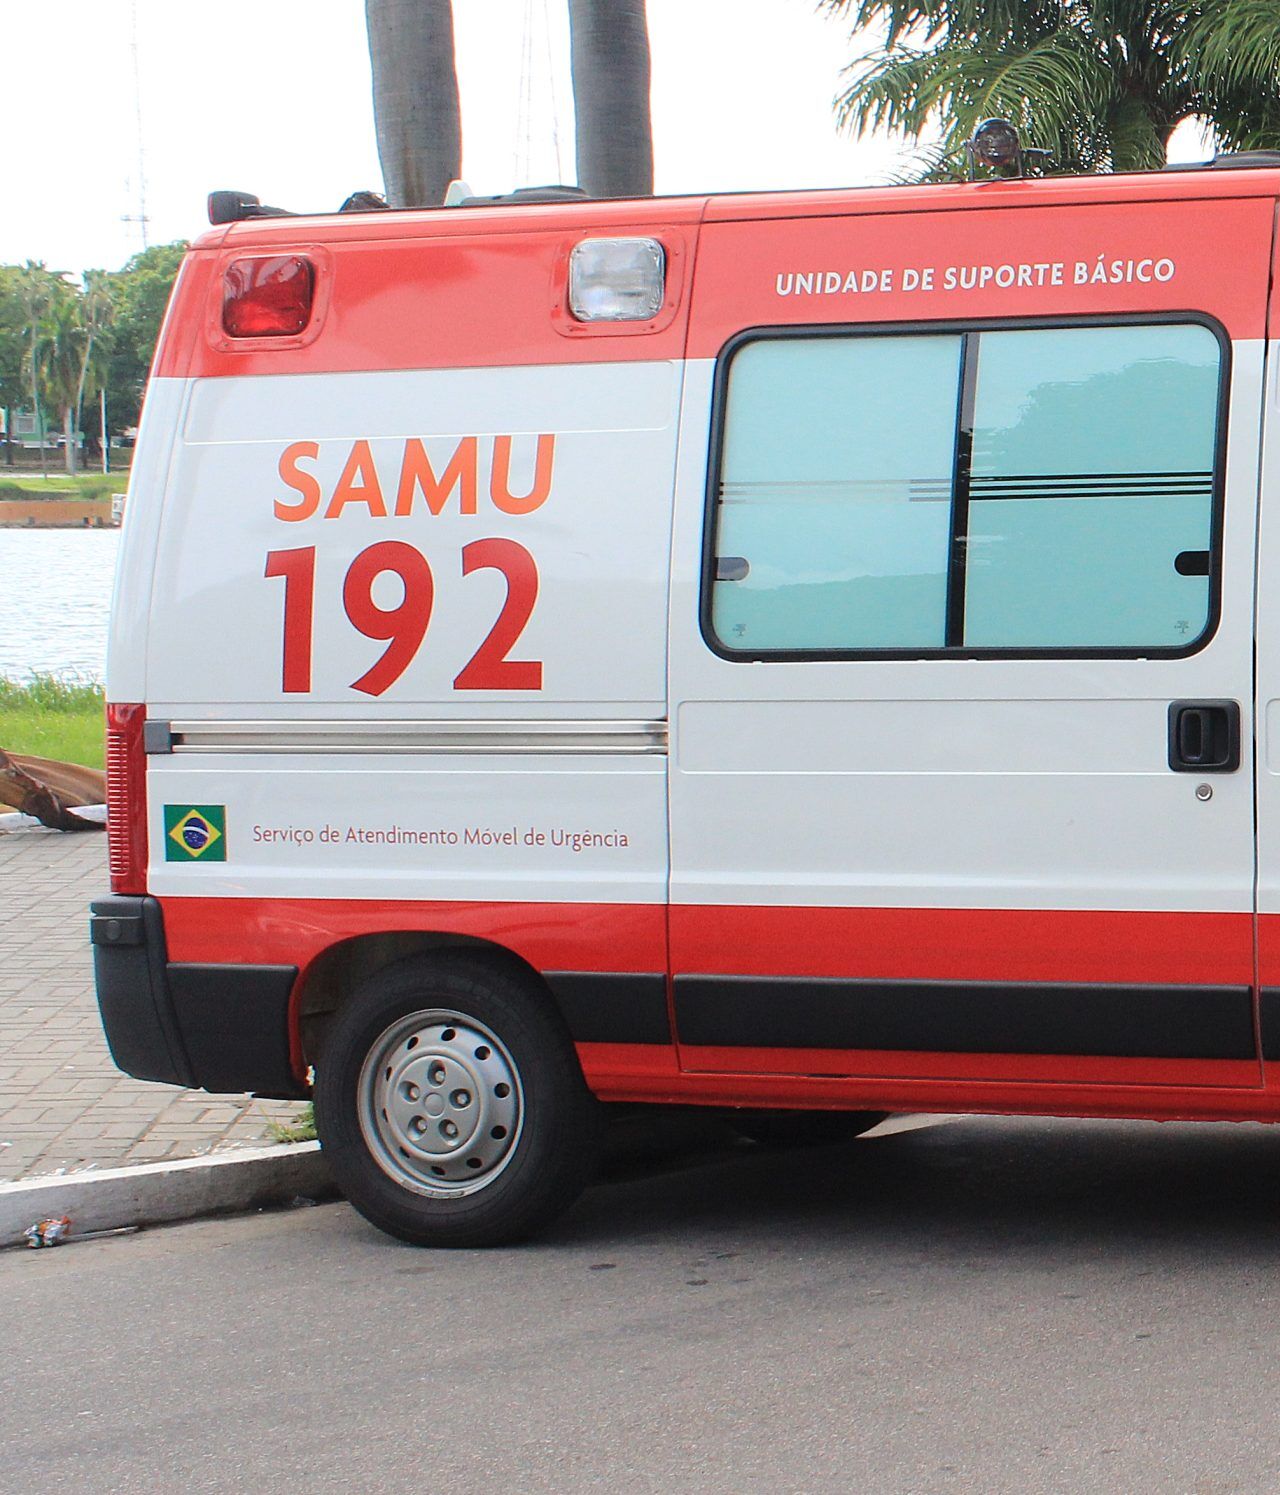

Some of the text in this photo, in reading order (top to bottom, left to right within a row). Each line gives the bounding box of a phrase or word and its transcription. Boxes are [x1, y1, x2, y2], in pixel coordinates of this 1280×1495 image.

[775, 254, 1176, 296] UNIDADE DE SUPORTE BÁSICO
[273, 433, 555, 522] SAMU
[264, 537, 543, 697] 192
[252, 824, 629, 851] Serviço de Atendimento Móvel de Urgência
